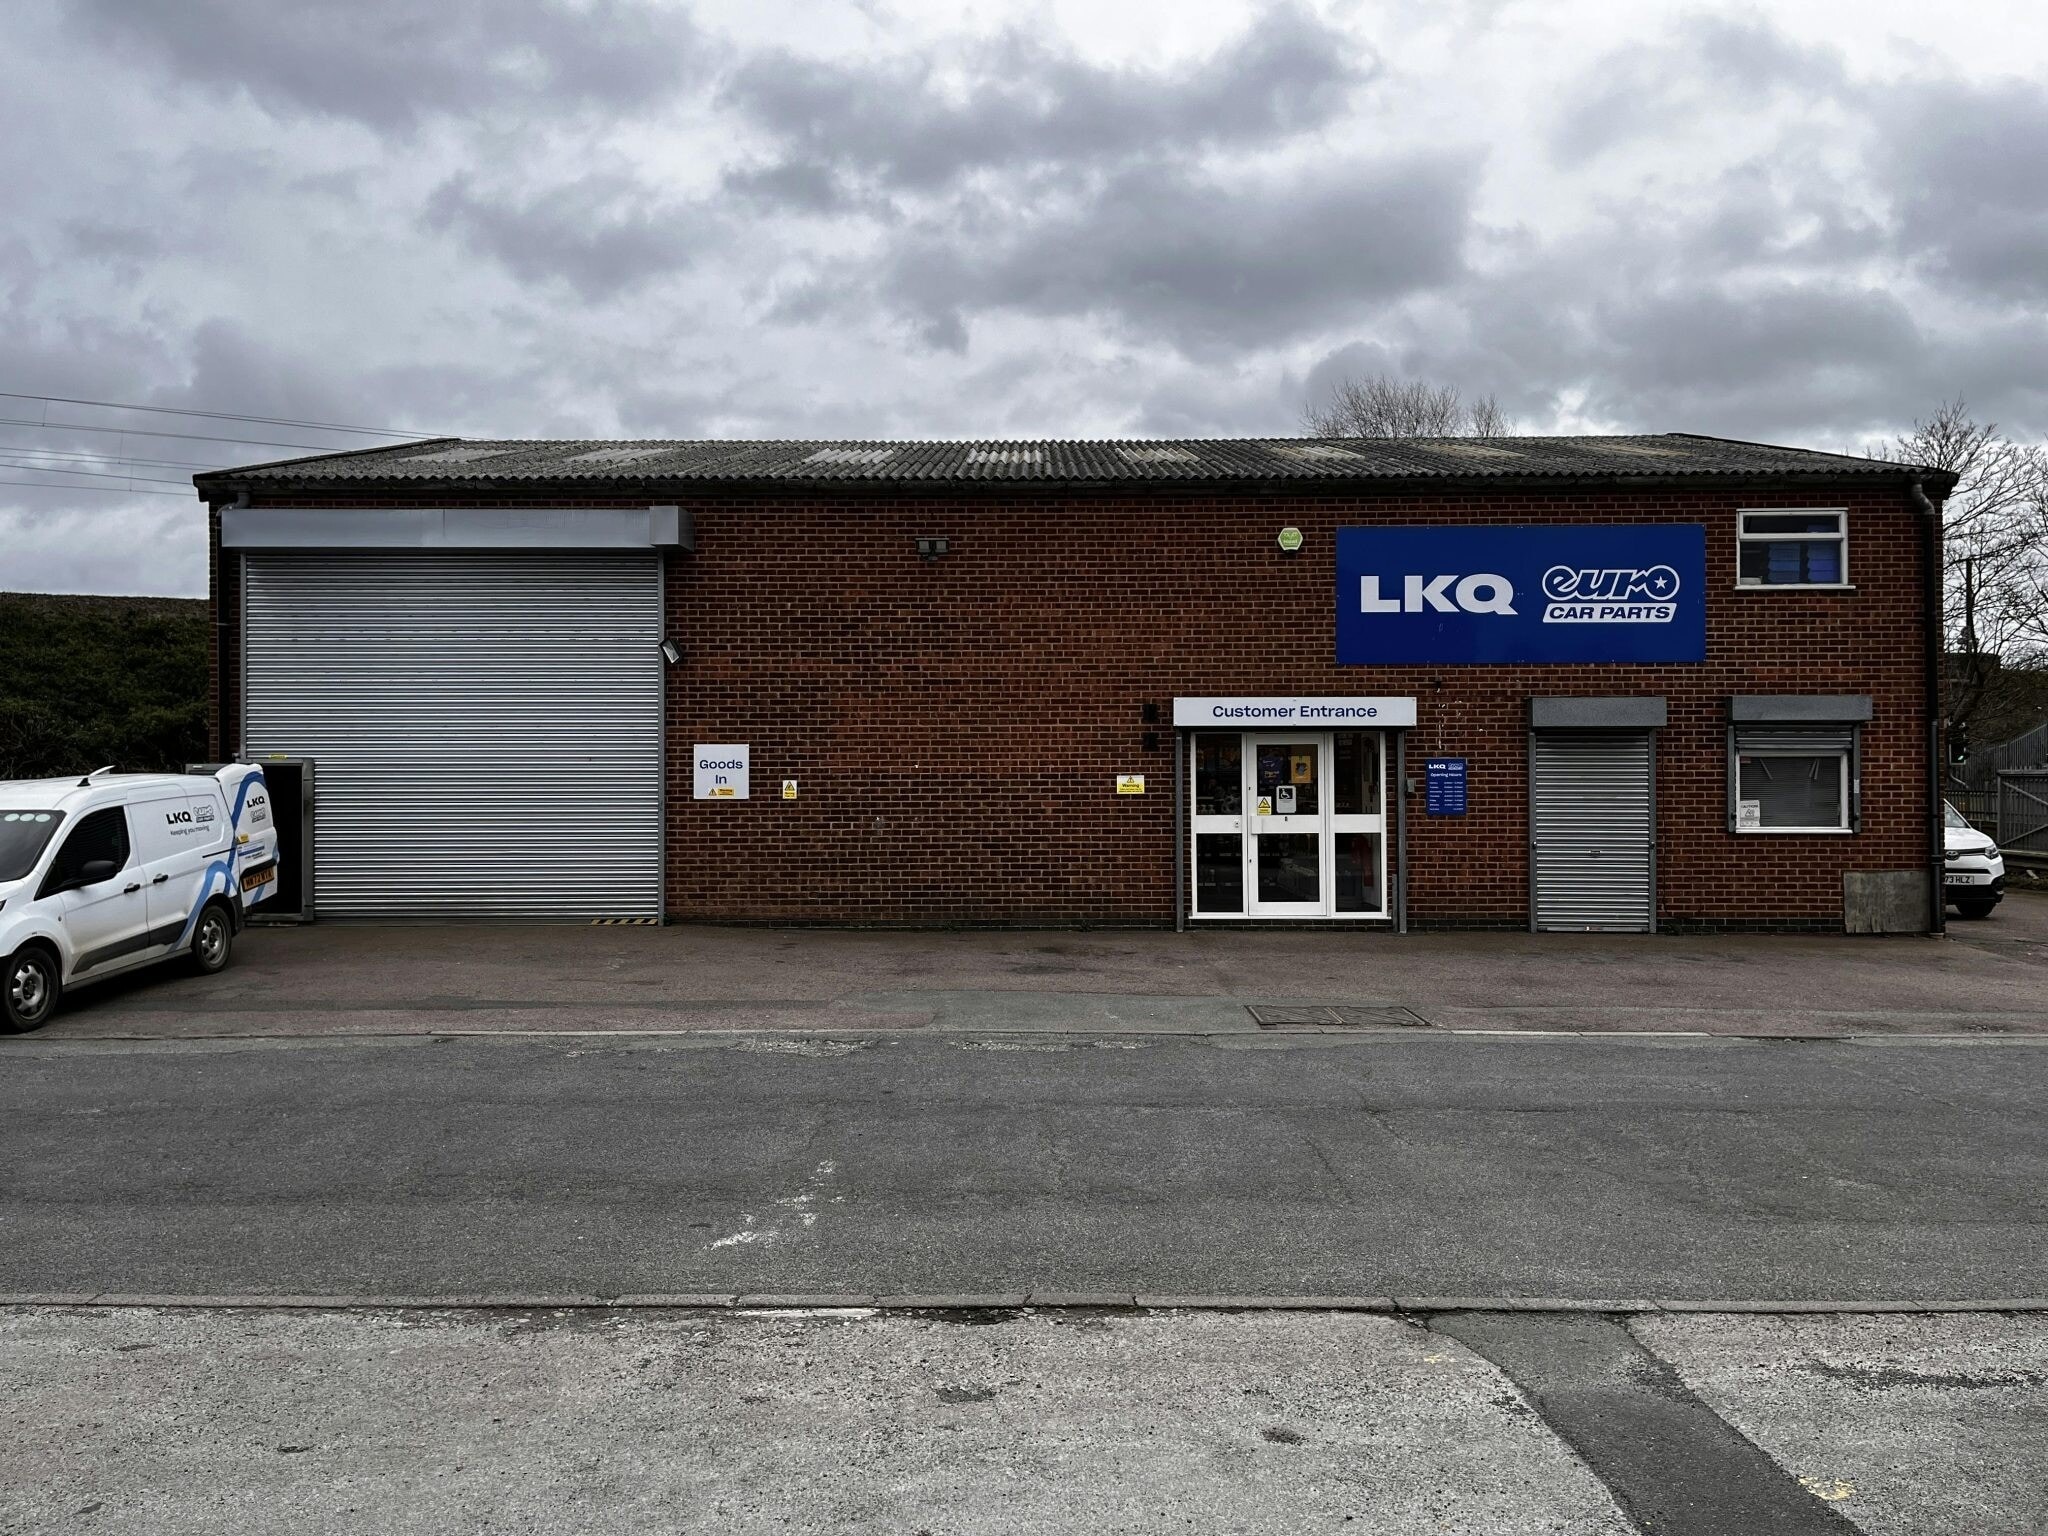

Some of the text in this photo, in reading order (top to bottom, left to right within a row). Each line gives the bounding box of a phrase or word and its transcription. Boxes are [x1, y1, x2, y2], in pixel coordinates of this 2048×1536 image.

[1542, 565, 1680, 601] euro
[1360, 573, 1518, 615] LKQ
[1549, 606, 1670, 619] CAR PARTS
[1212, 705, 1378, 718] Customer Entrance
[699, 759, 743, 769] Goods
[715, 774, 727, 784] In
[246, 795, 265, 808] LKQ
[166, 811, 192, 824] LKQ
